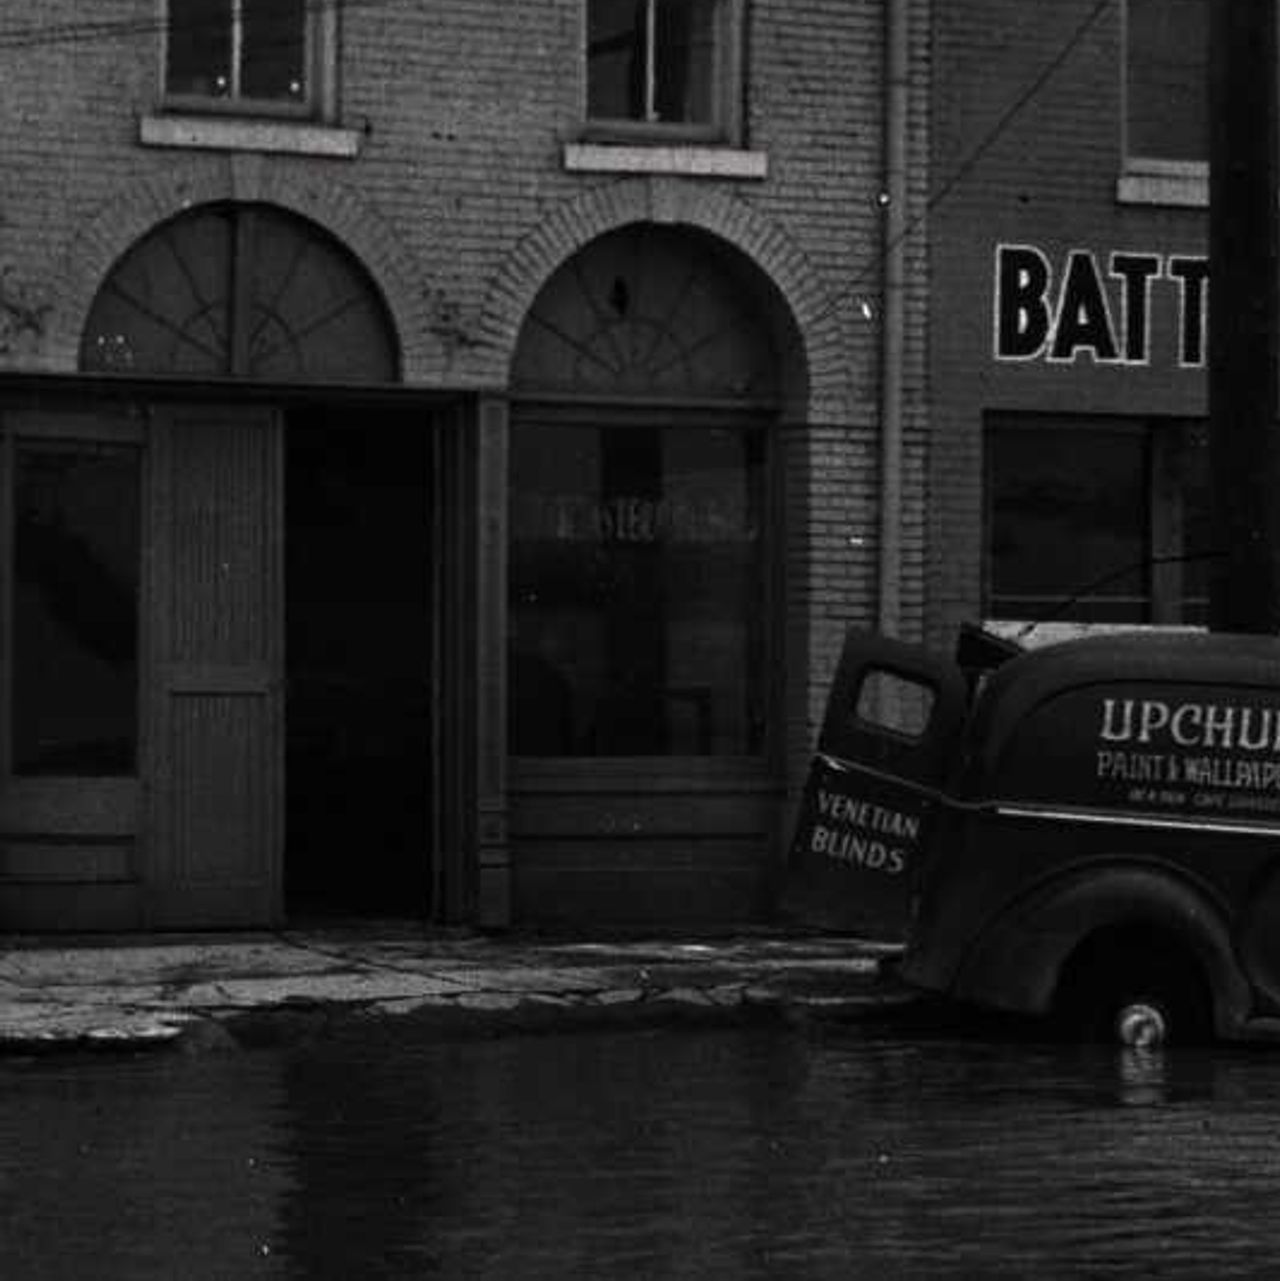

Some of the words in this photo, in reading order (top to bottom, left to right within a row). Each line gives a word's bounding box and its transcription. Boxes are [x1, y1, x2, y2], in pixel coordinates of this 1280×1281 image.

[1096, 750, 1165, 780] PAINT
[817, 787, 921, 839] VENETIAN
[811, 824, 905, 875] BLINDS
